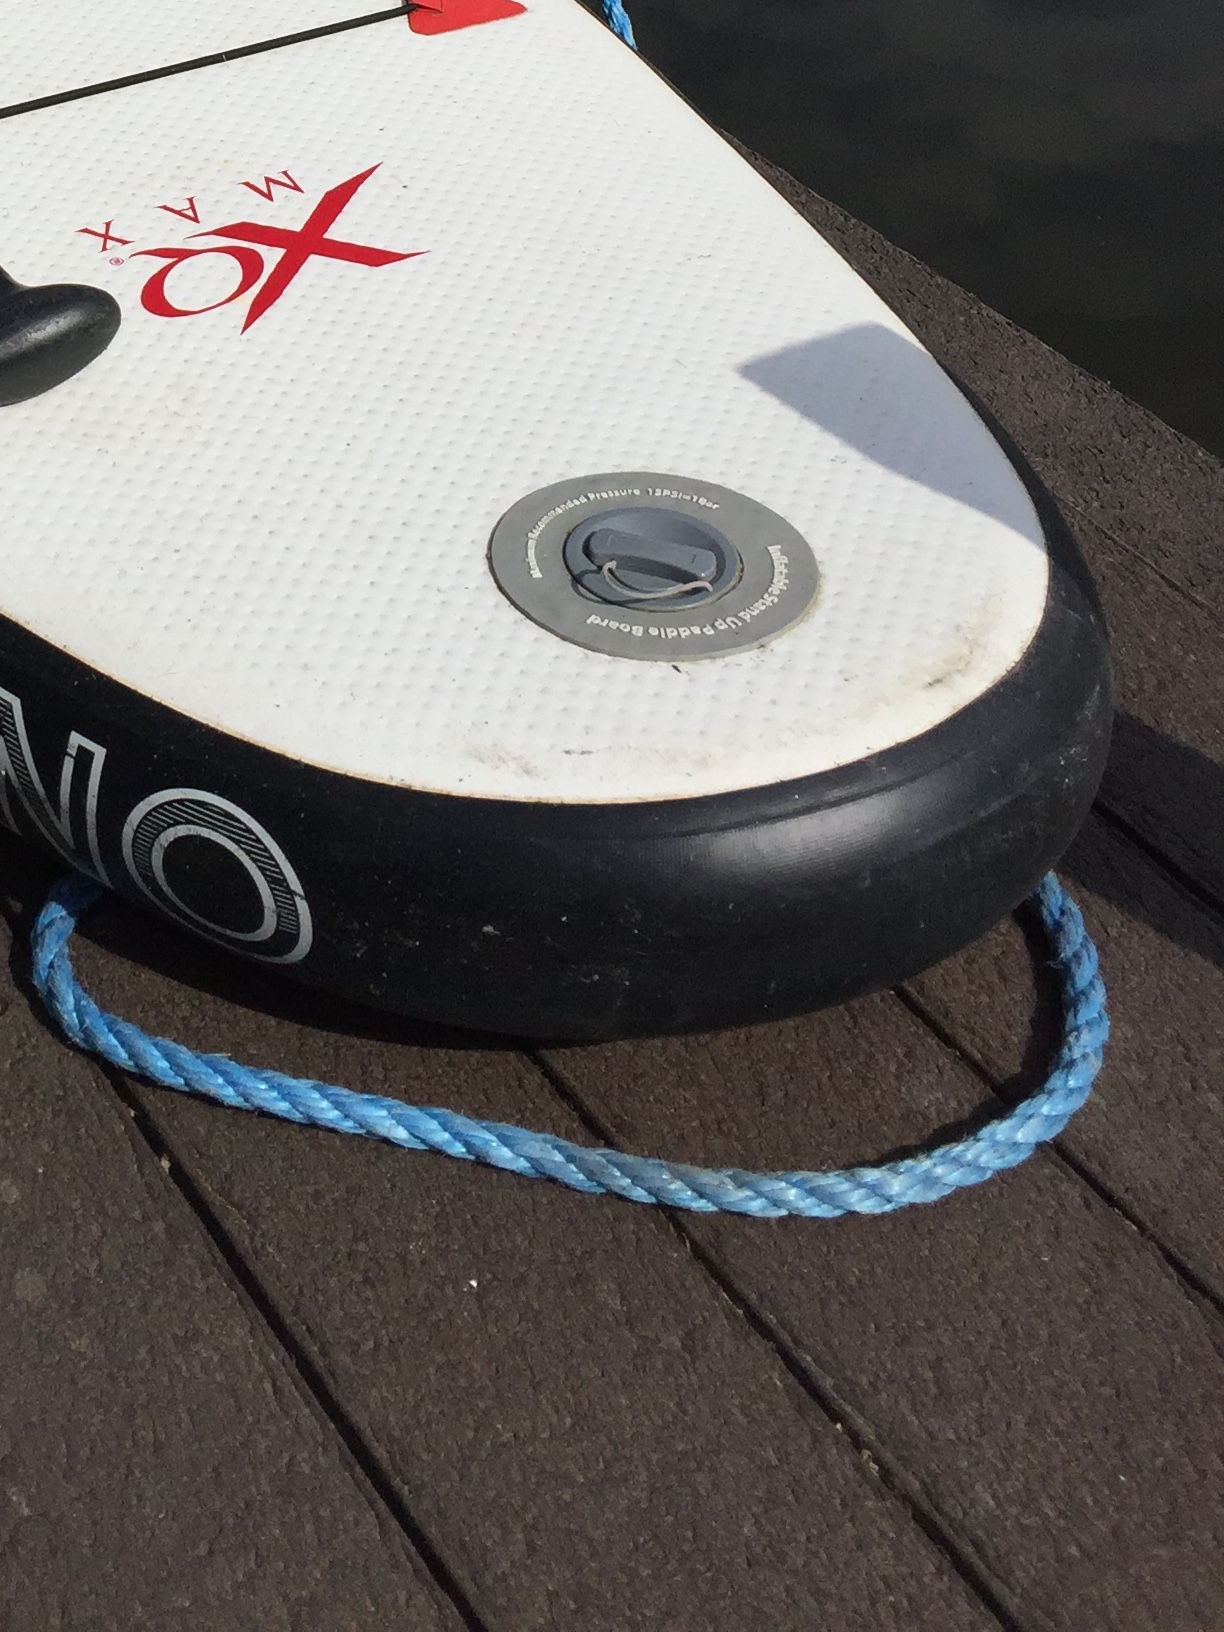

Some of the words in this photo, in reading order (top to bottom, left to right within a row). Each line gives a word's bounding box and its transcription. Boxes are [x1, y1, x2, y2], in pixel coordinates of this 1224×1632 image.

[75, 170, 304, 252] MAX
[588, 487, 640, 502] Pressure
[737, 592, 779, 623] Stand
[586, 614, 643, 637] Board
[648, 626, 715, 639] Paddle
[714, 616, 743, 632] Up
